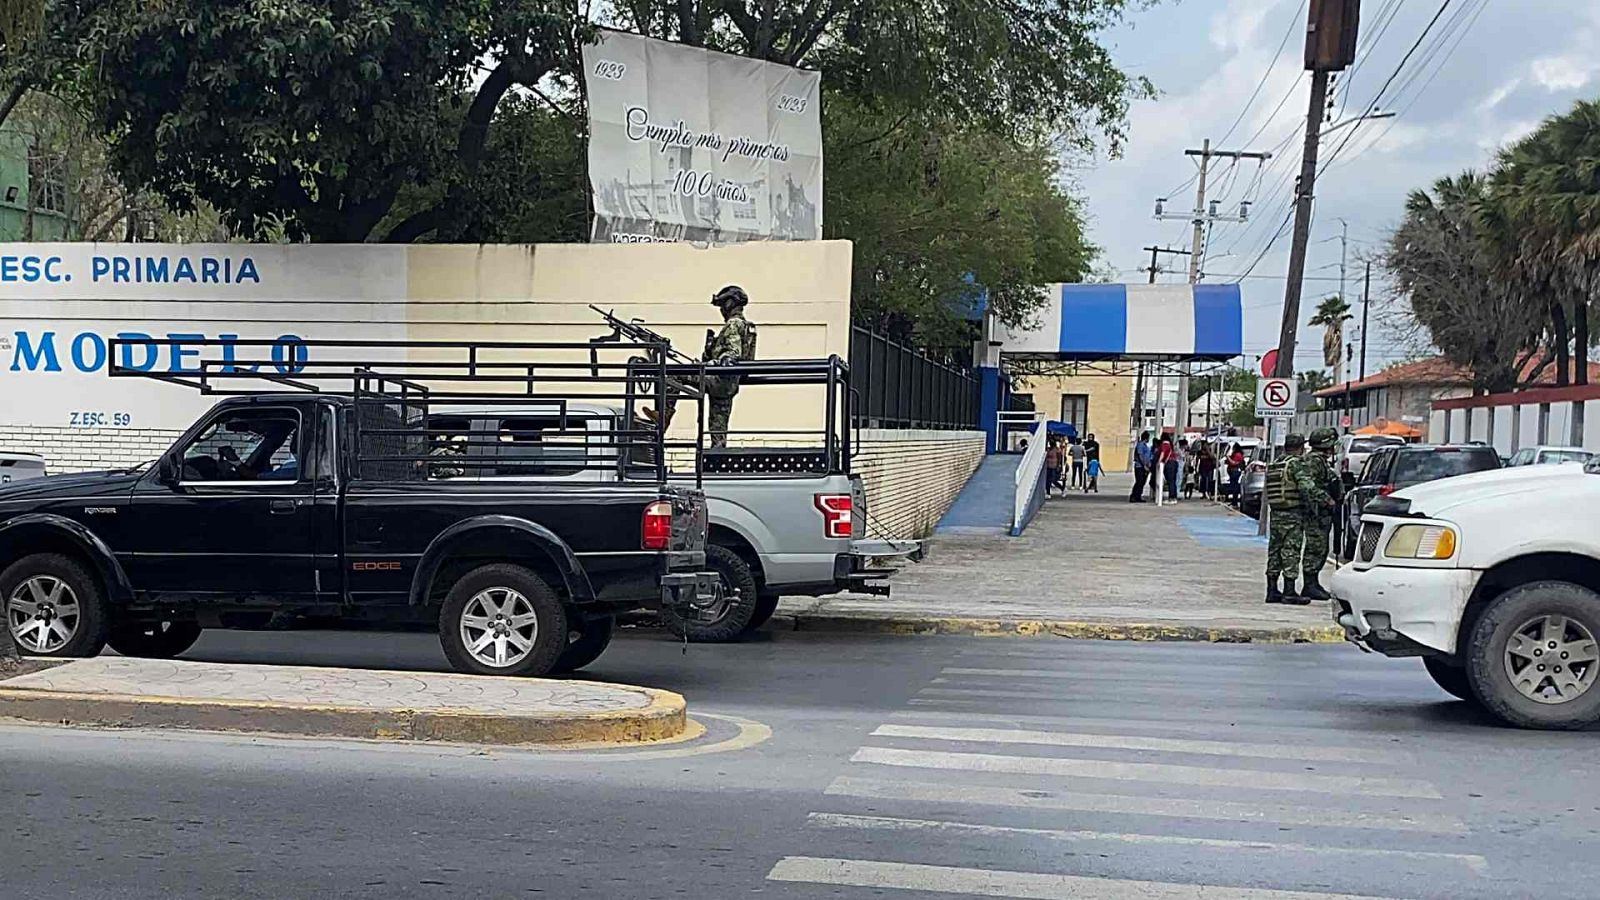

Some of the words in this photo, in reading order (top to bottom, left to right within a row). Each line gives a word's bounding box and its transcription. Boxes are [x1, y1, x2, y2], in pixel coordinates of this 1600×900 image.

[594, 61, 625, 79] 1923
[777, 95, 806, 113] 2023
[626, 107, 692, 153] Cumplo
[695, 133, 721, 150] mis
[722, 137, 789, 162] primeros
[673, 170, 713, 196] 100
[716, 180, 747, 202] años
[1, 256, 71, 282] ESC.
[92, 257, 260, 283] PRIMARIA
[10, 331, 308, 373] MODELO
[113, 413, 130, 426] 59
[353, 561, 402, 570] EDGE
